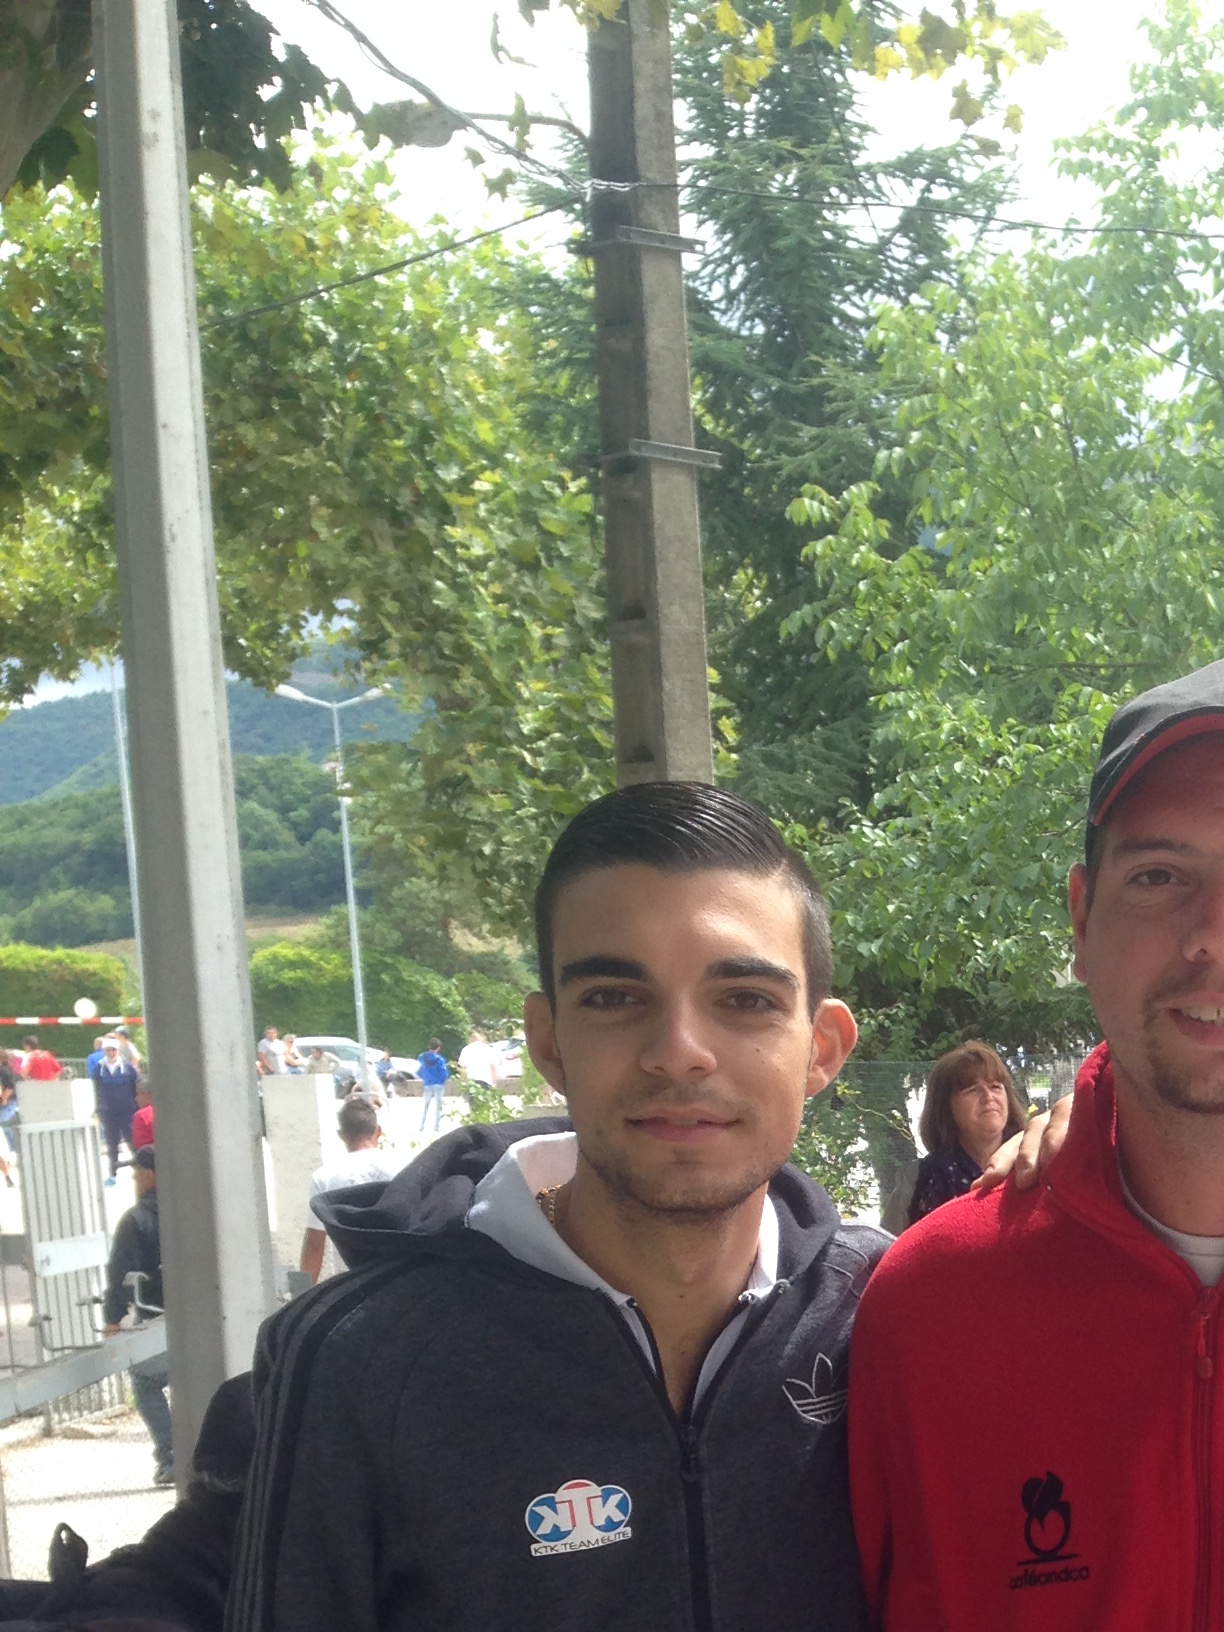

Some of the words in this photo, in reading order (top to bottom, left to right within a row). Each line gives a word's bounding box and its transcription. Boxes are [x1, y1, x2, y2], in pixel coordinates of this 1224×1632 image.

[533, 1544, 559, 1556] KTK
[561, 1539, 600, 1552] TEAM
[600, 1530, 630, 1545] ELITE
